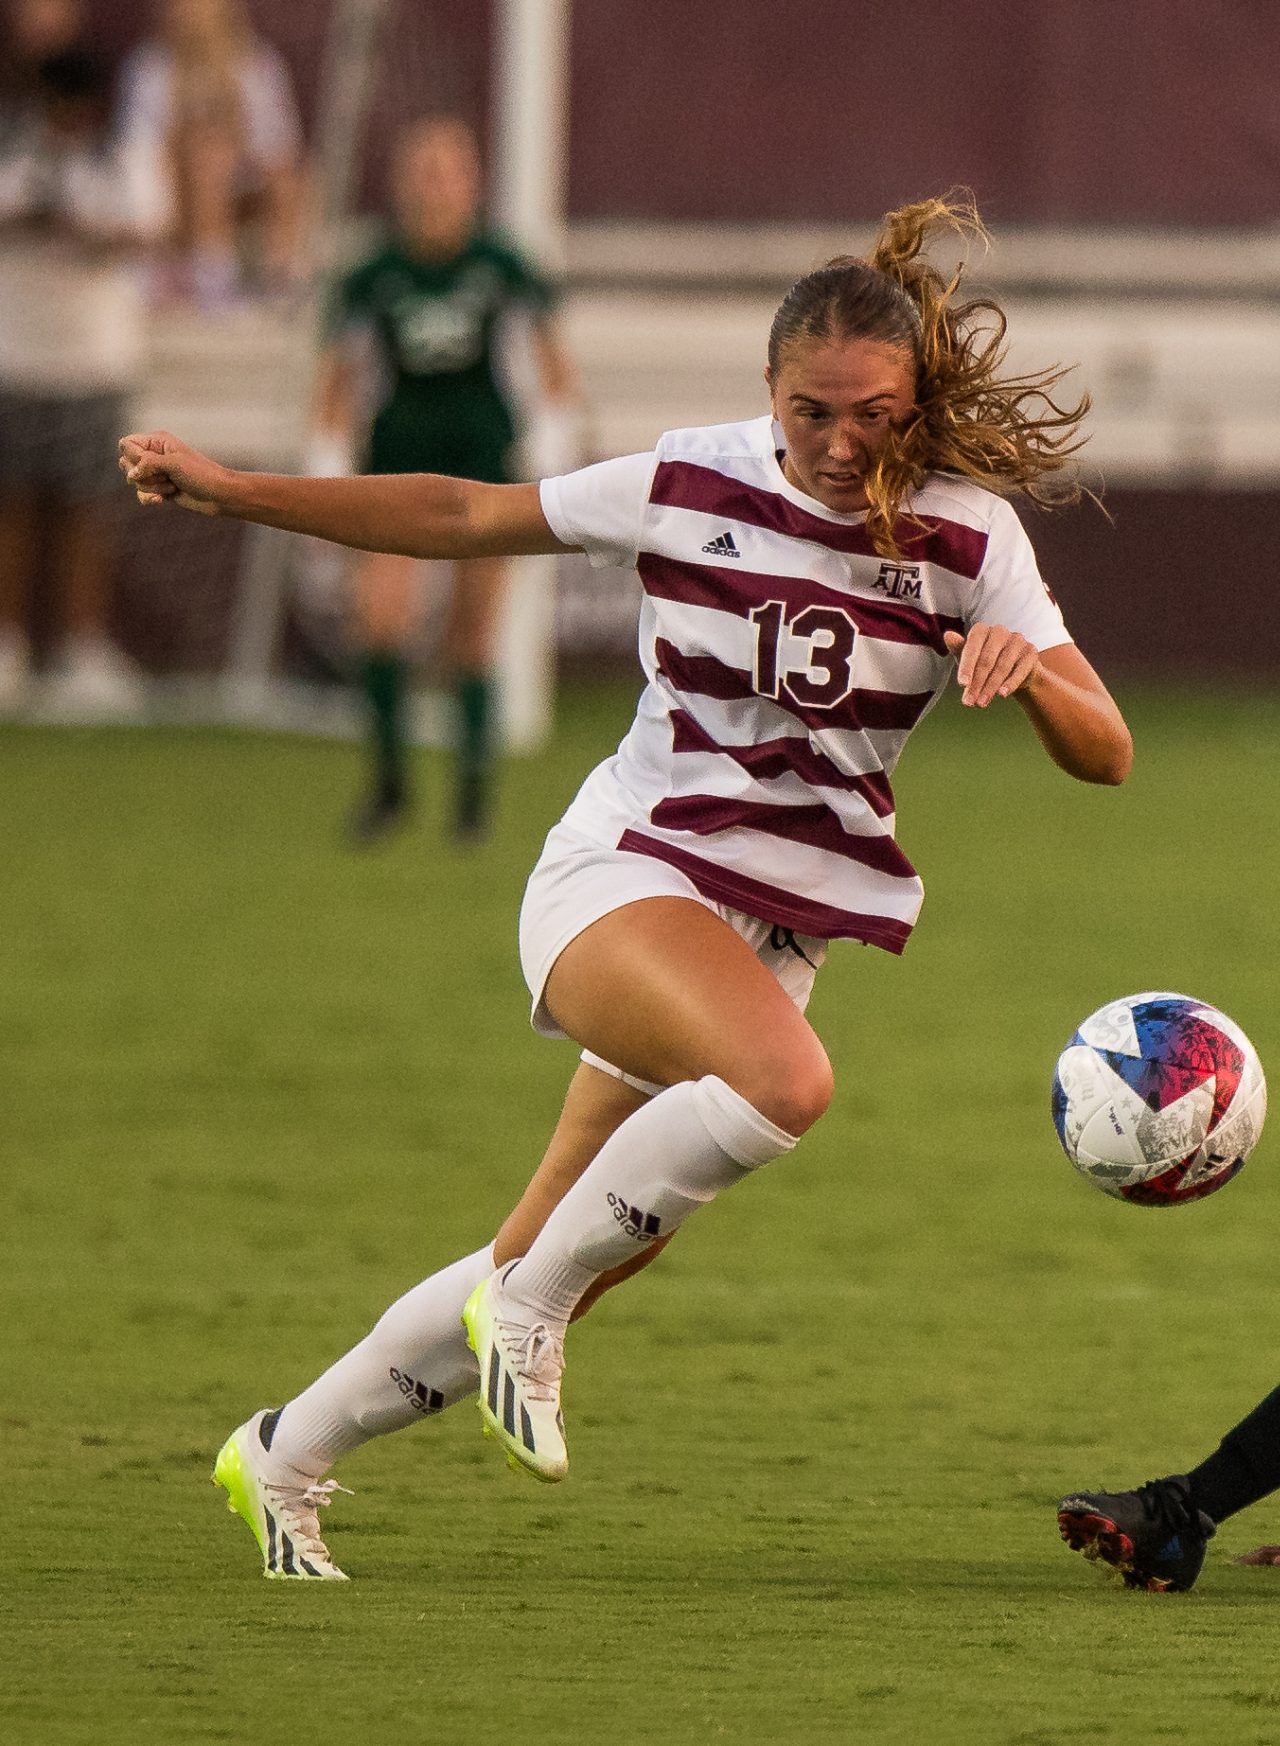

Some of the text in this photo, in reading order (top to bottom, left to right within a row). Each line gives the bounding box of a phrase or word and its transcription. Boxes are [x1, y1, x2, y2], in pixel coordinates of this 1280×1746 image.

[701, 545, 741, 558] adidas
[749, 599, 860, 710] 13
[607, 1191, 653, 1242] adida
